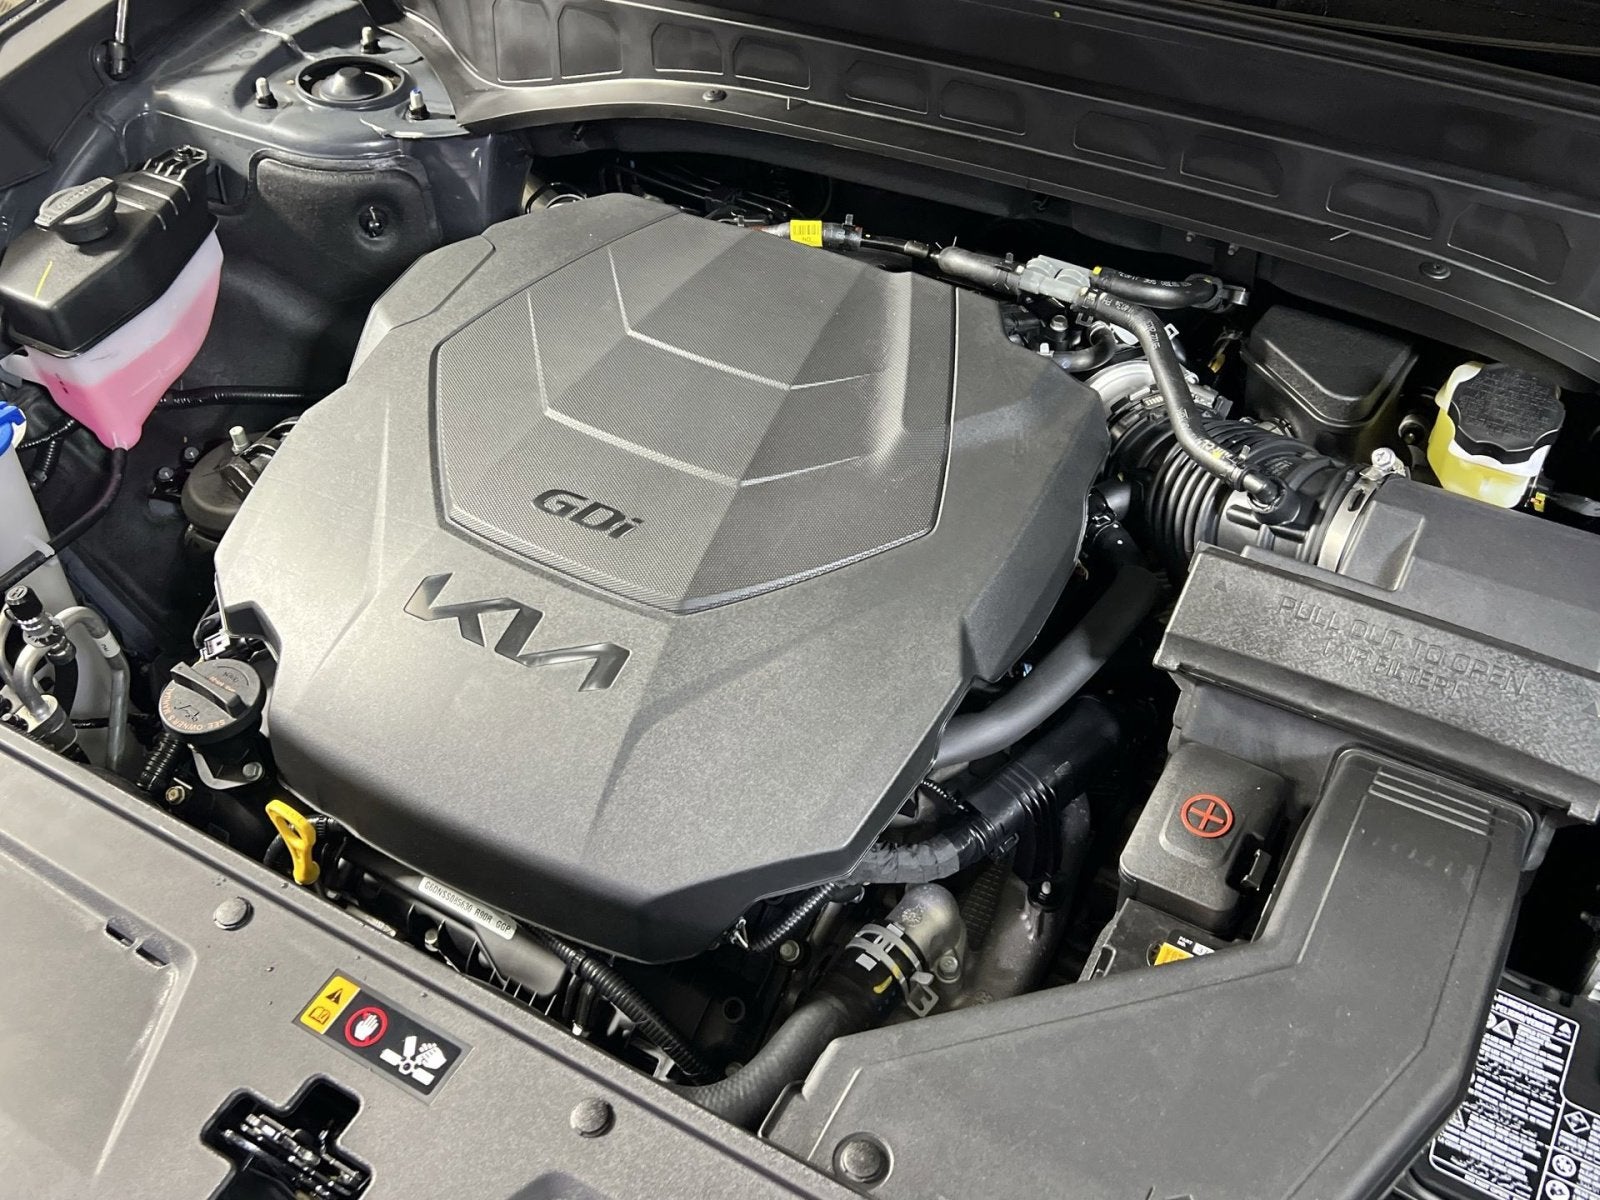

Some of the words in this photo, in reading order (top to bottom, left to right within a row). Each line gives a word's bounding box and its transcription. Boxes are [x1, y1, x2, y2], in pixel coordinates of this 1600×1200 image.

[532, 488, 645, 539] GDi
[1277, 594, 1341, 632] PULL
[1350, 618, 1405, 650] OUT
[1412, 636, 1443, 664] TO
[1450, 652, 1529, 697] OPEN
[207, 720, 226, 729] SEE
